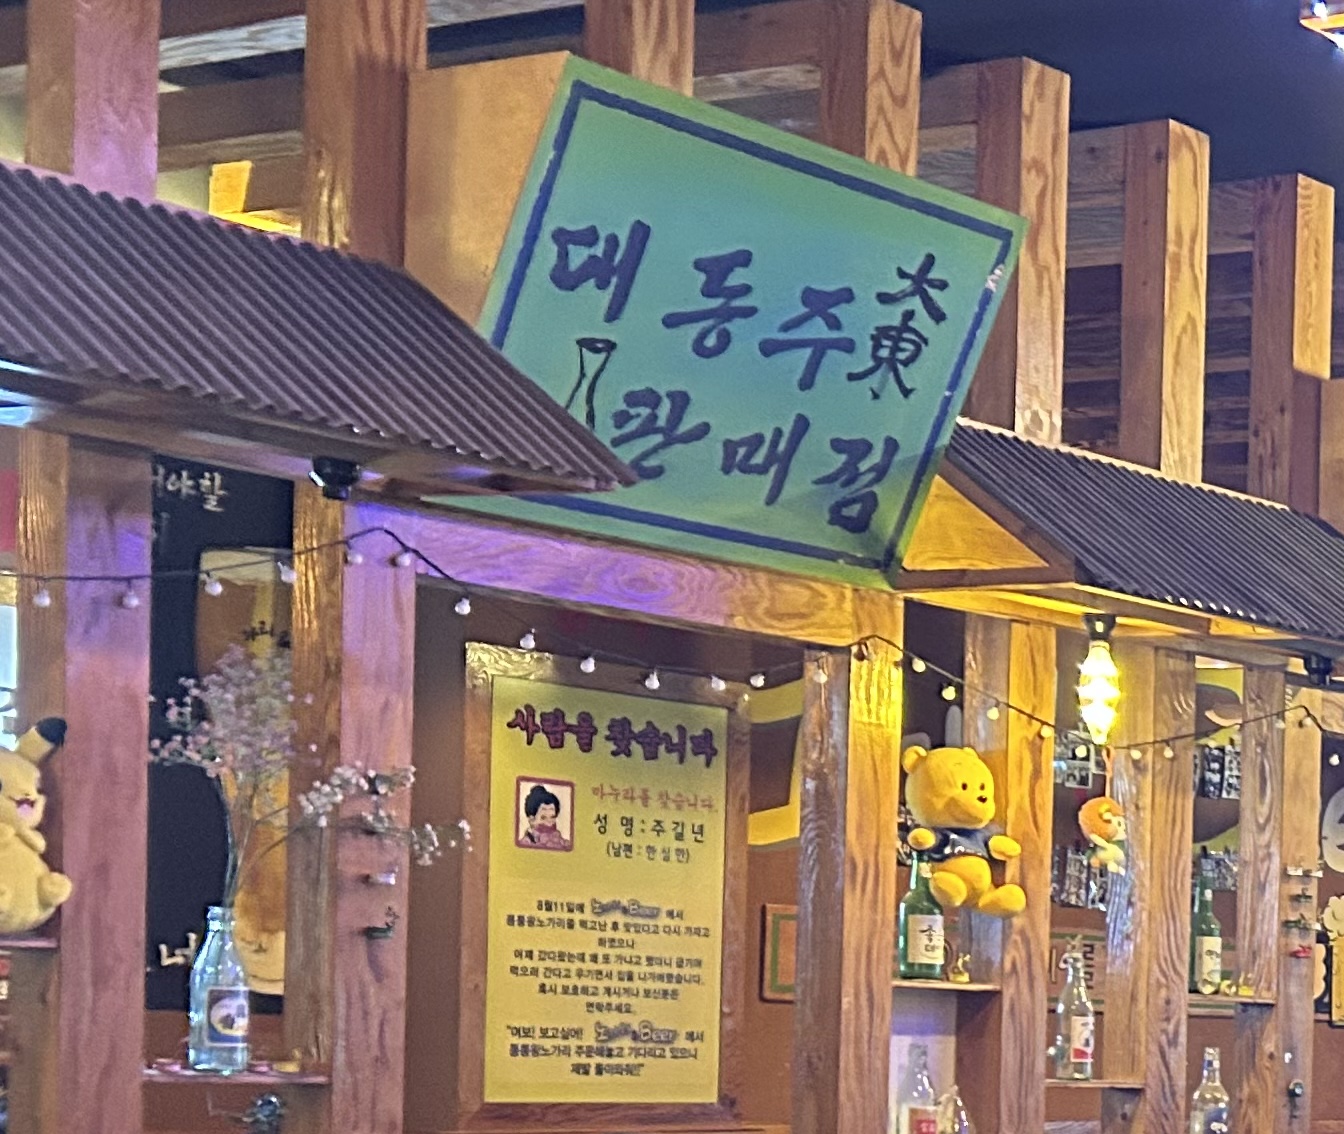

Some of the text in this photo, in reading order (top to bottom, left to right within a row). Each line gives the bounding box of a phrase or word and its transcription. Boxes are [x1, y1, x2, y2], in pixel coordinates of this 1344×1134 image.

[550, 219, 856, 392] 대동주
[847, 252, 949, 400] 大東
[610, 387, 899, 534] 판매점
[507, 704, 718, 768] 사람을 찾습니다
[591, 784, 651, 809] 마누라를
[610, 920, 620, 931] 후
[662, 923, 681, 936] 다시
[513, 949, 534, 961] 어제
[601, 953, 611, 964] 또
[543, 967, 571, 980] 간다고
[538, 983, 558, 995] 혹시
